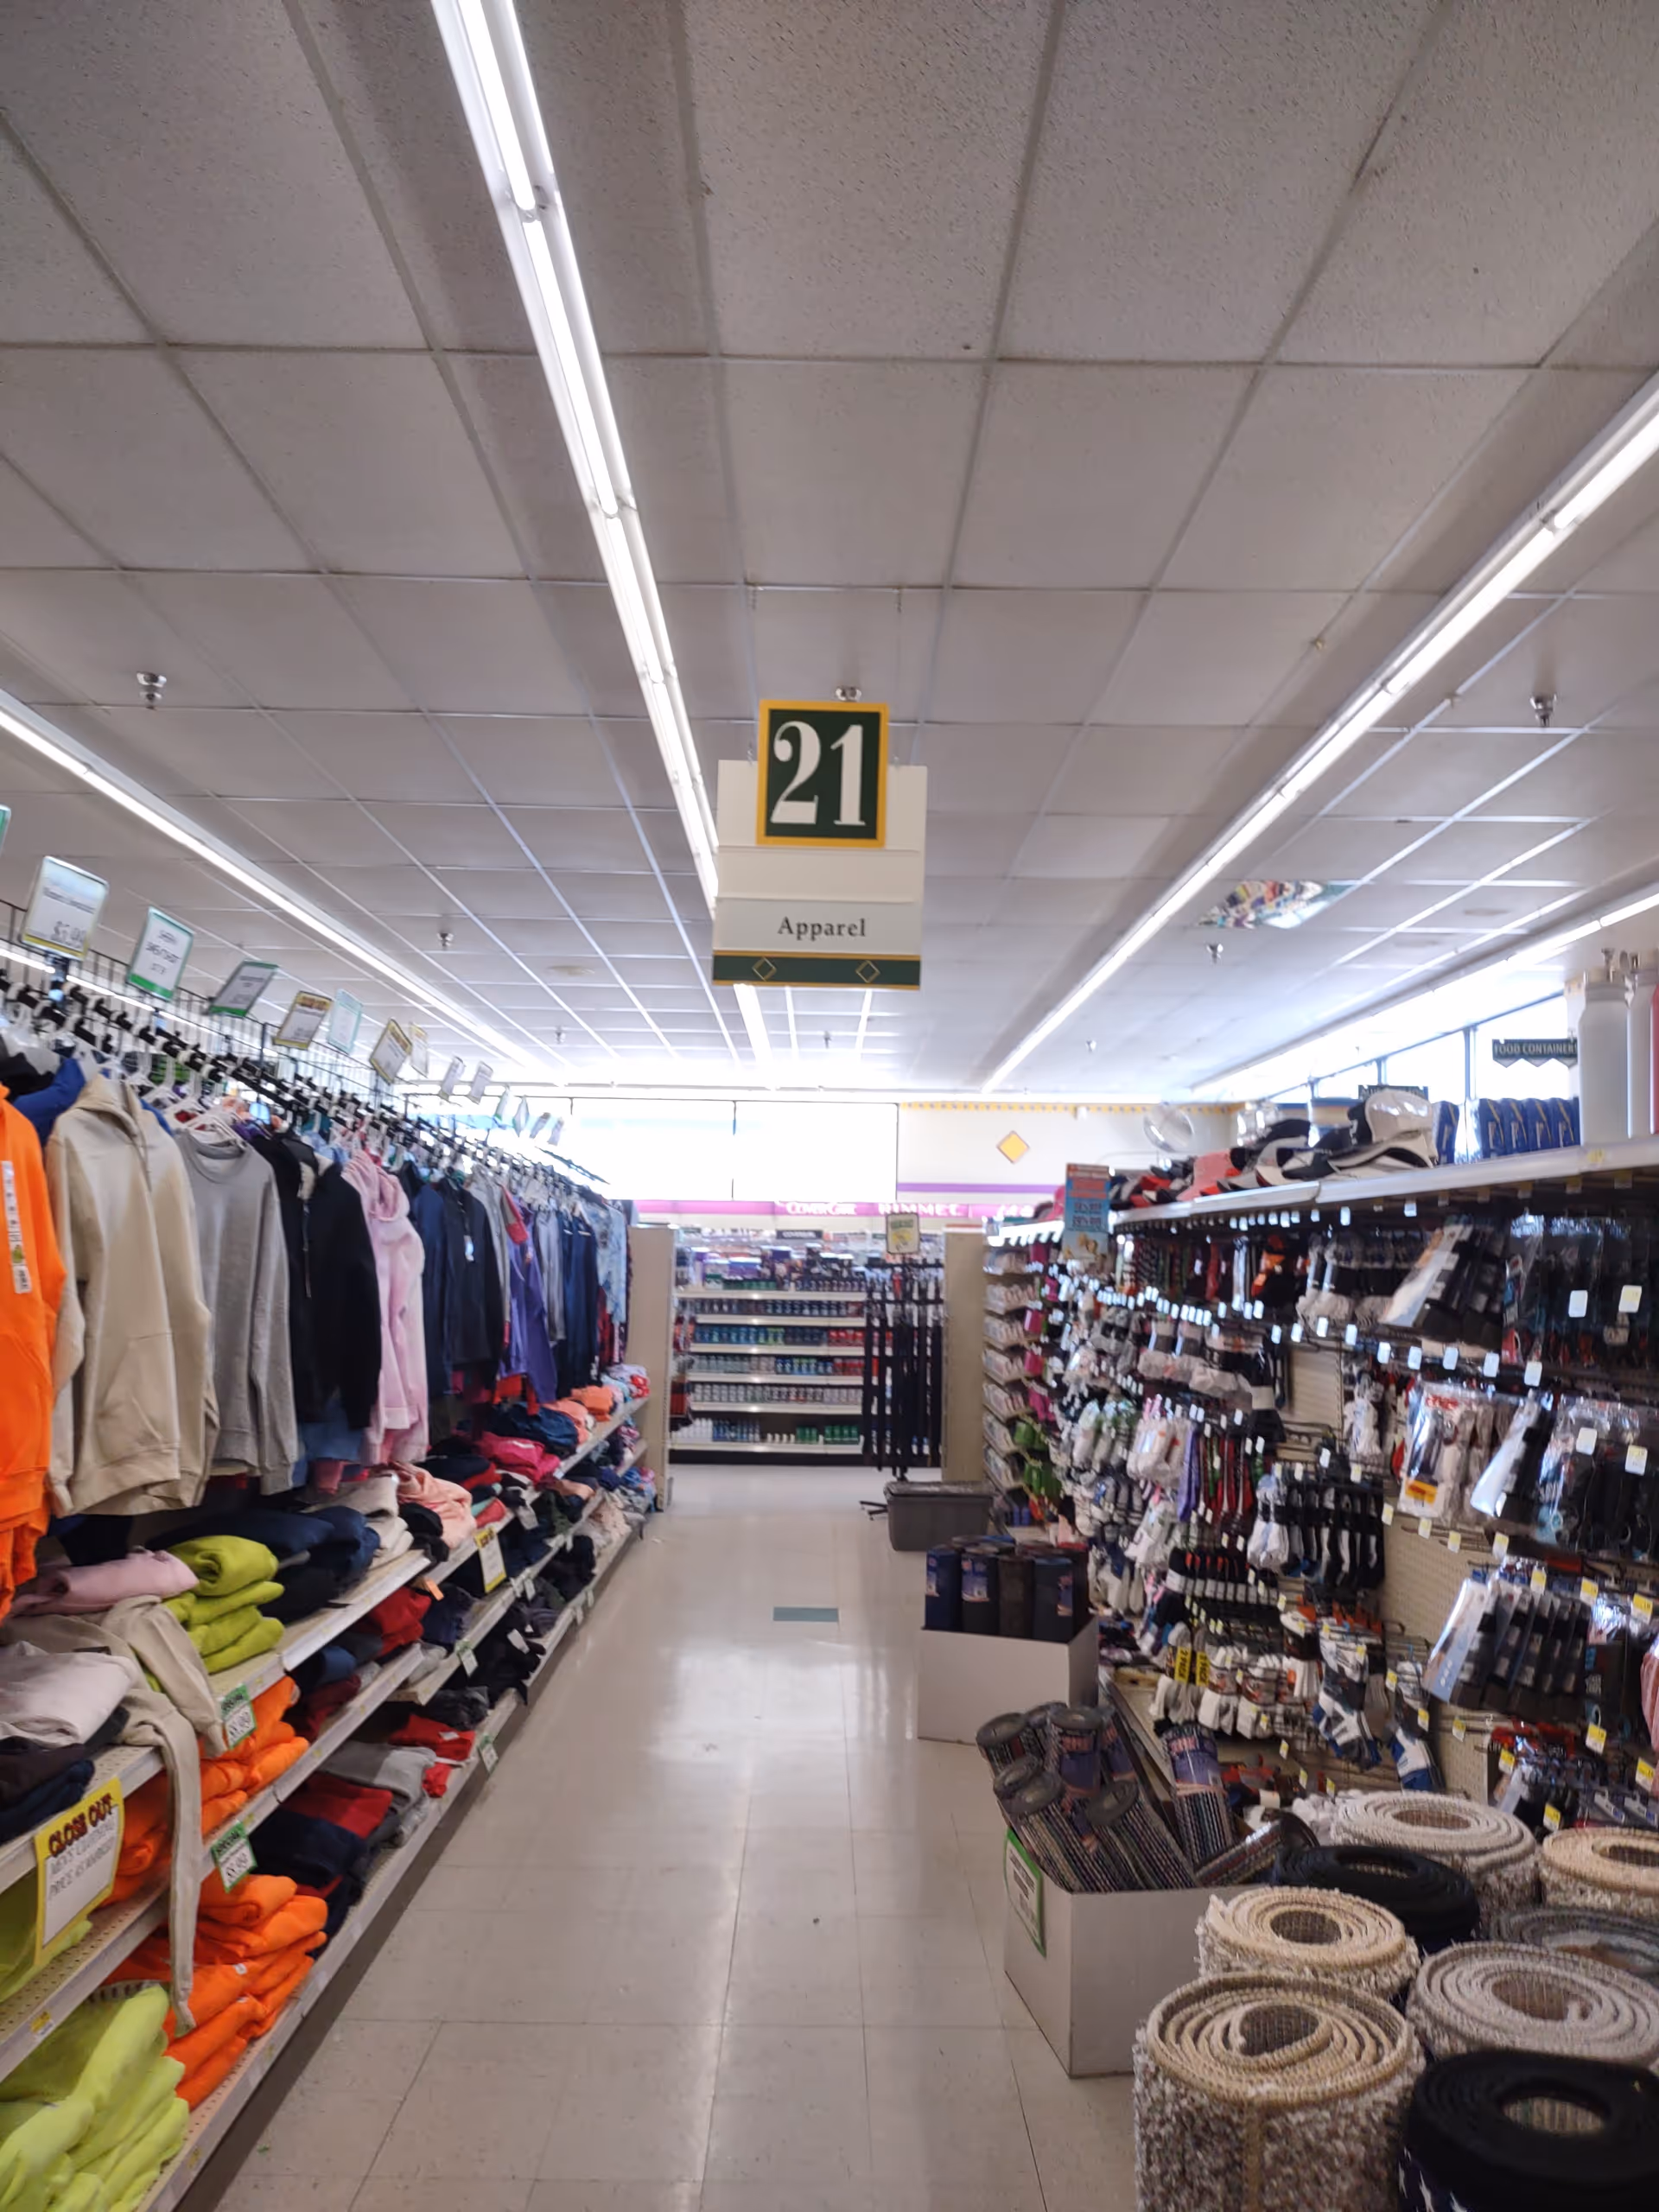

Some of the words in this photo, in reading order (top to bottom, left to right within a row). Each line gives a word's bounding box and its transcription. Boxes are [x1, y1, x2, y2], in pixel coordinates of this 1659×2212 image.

[771, 721, 866, 826] 21
[777, 916, 867, 942] Apparel
[1494, 1042, 1520, 1054] FOOD
[49, 1812, 88, 1858] CLOSE
[88, 1792, 112, 1827] OUT
